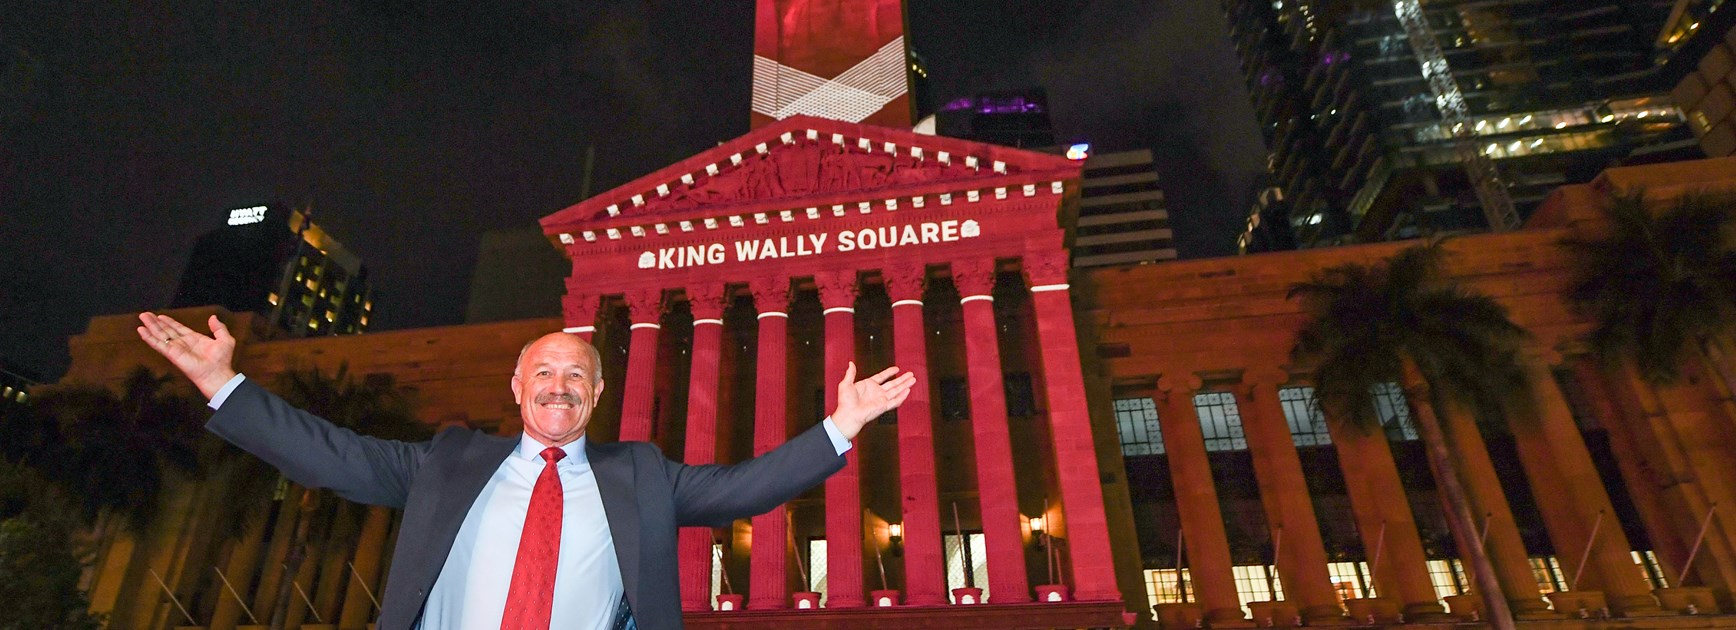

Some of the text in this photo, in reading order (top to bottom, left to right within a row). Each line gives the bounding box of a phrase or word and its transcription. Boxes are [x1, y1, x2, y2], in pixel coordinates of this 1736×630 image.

[658, 219, 960, 269] KING WALLY SQUARE
